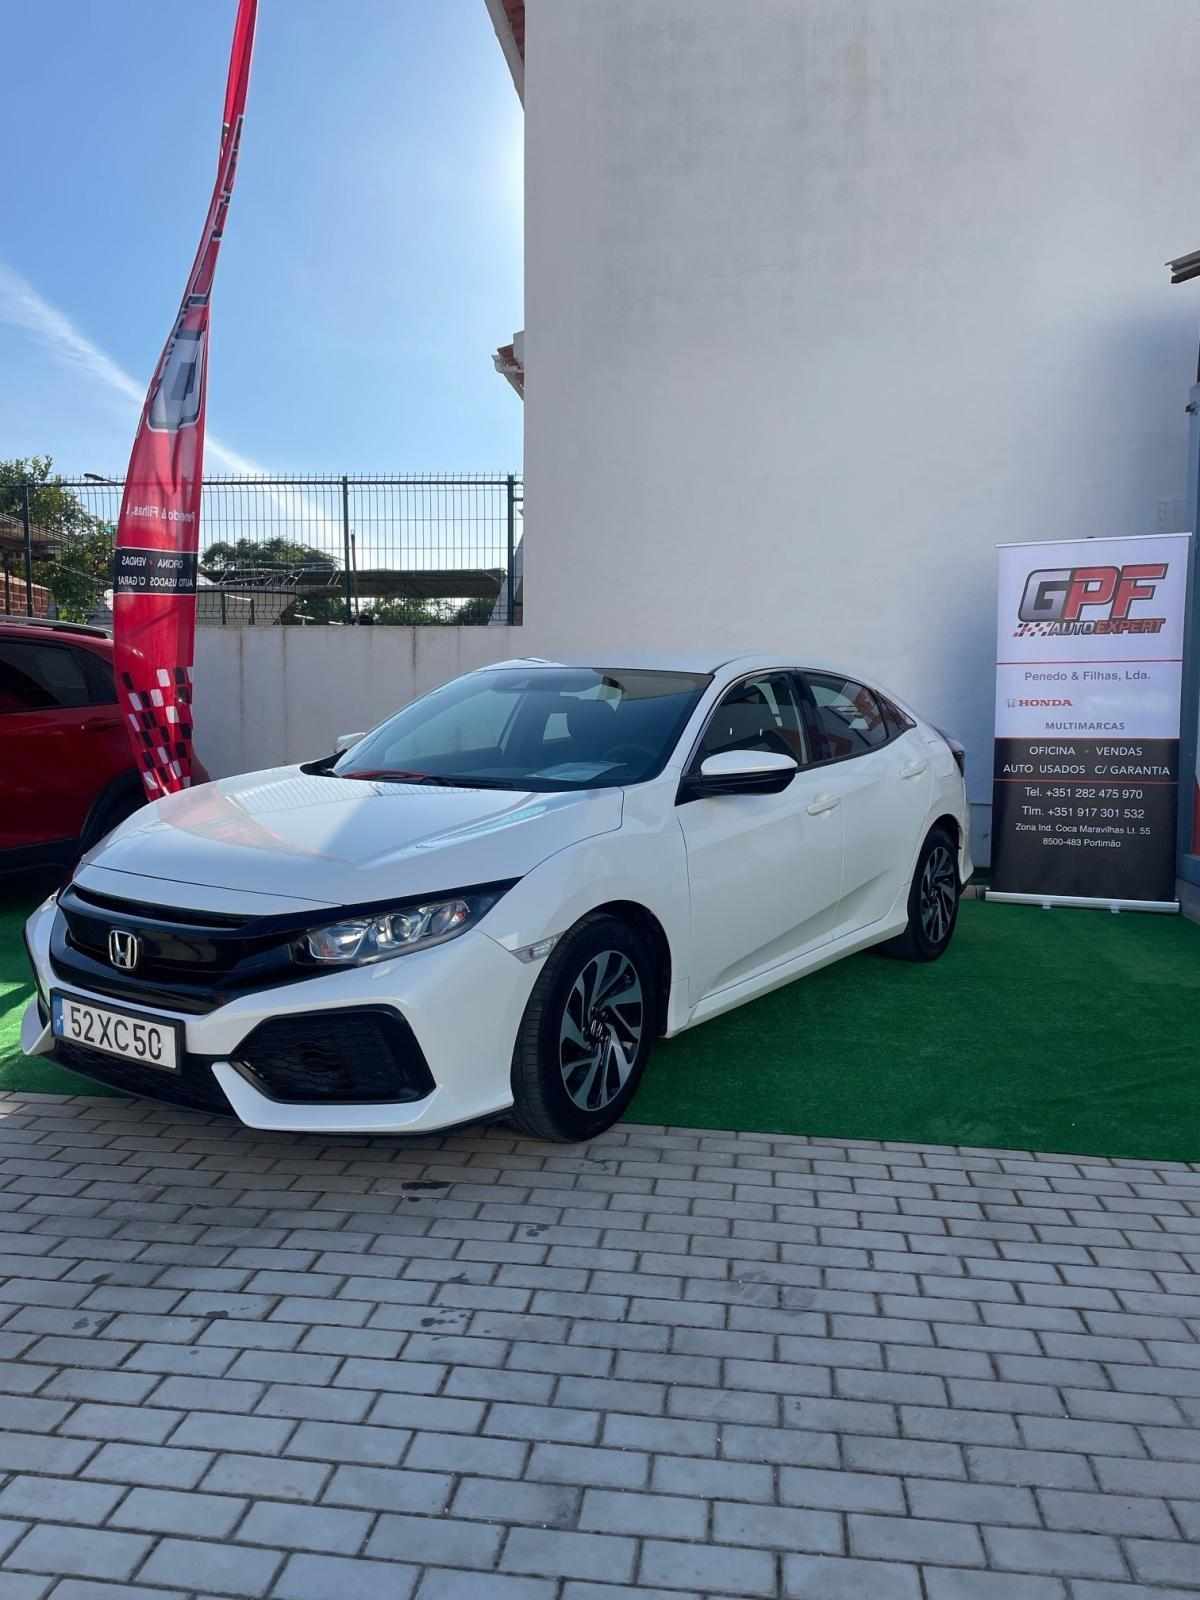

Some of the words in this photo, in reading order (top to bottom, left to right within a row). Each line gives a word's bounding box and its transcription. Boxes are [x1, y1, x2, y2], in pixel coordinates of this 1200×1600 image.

[1018, 563, 1169, 622] GPF
[1024, 671, 1068, 682] Penedo
[1071, 672, 1080, 681] &
[1083, 671, 1121, 682] Filhas,
[1125, 670, 1151, 680] Lda.
[1018, 698, 1073, 707] HONDA
[1045, 722, 1126, 730] MULTIMARCAS
[1029, 746, 1076, 756] OFICINA
[1096, 747, 1143, 757] VENDAS
[1003, 764, 1033, 774] AUTO
[1039, 764, 1086, 774] USADOS
[1094, 765, 1107, 775] C/
[1110, 766, 1171, 776] GARANTIA
[1024, 787, 1042, 798] Tel.
[1046, 787, 1071, 798] +351
[1075, 788, 1096, 798] 282
[1098, 788, 1119, 799] 475
[1122, 789, 1143, 800] 970
[1047, 806, 1073, 817] +351
[1077, 807, 1097, 817] 917
[1100, 808, 1120, 818] 301
[1123, 808, 1145, 819] 532
[1015, 823, 1036, 832] Zona
[1055, 824, 1078, 833] Coca
[1079, 825, 1124, 835] Maravilhas
[1139, 827, 1151, 836] 55
[1083, 839, 1121, 848] Portimão
[70, 1005, 162, 1060] 52XC50
